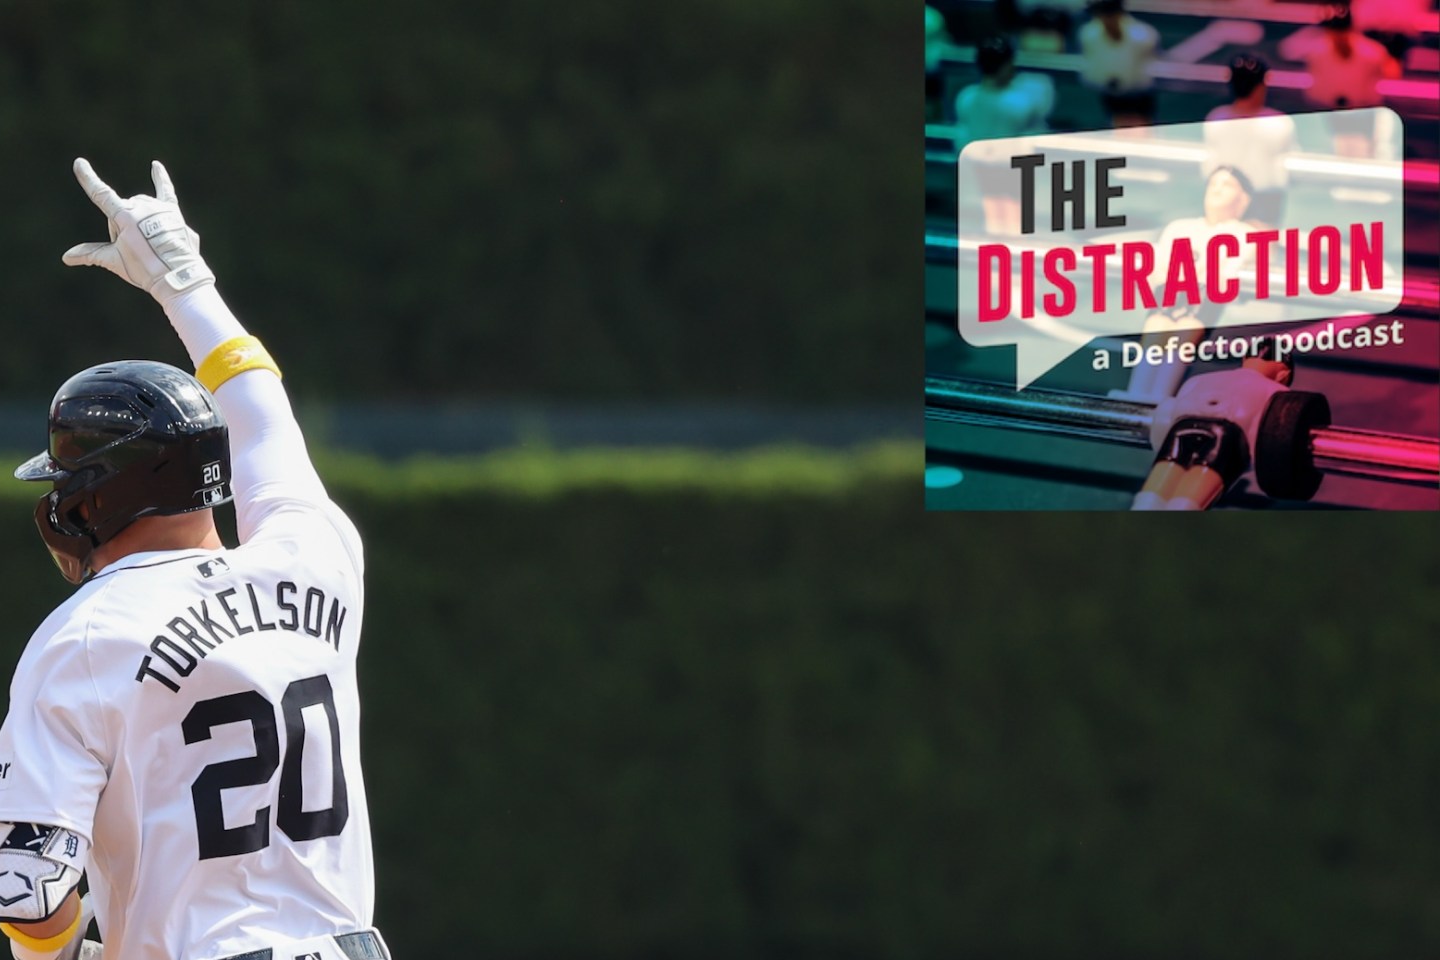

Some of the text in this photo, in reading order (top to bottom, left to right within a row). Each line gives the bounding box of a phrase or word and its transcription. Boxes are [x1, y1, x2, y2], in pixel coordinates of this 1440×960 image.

[202, 463, 221, 484] 20
[135, 581, 348, 693] TORKELSON
[180, 674, 350, 861] 20
